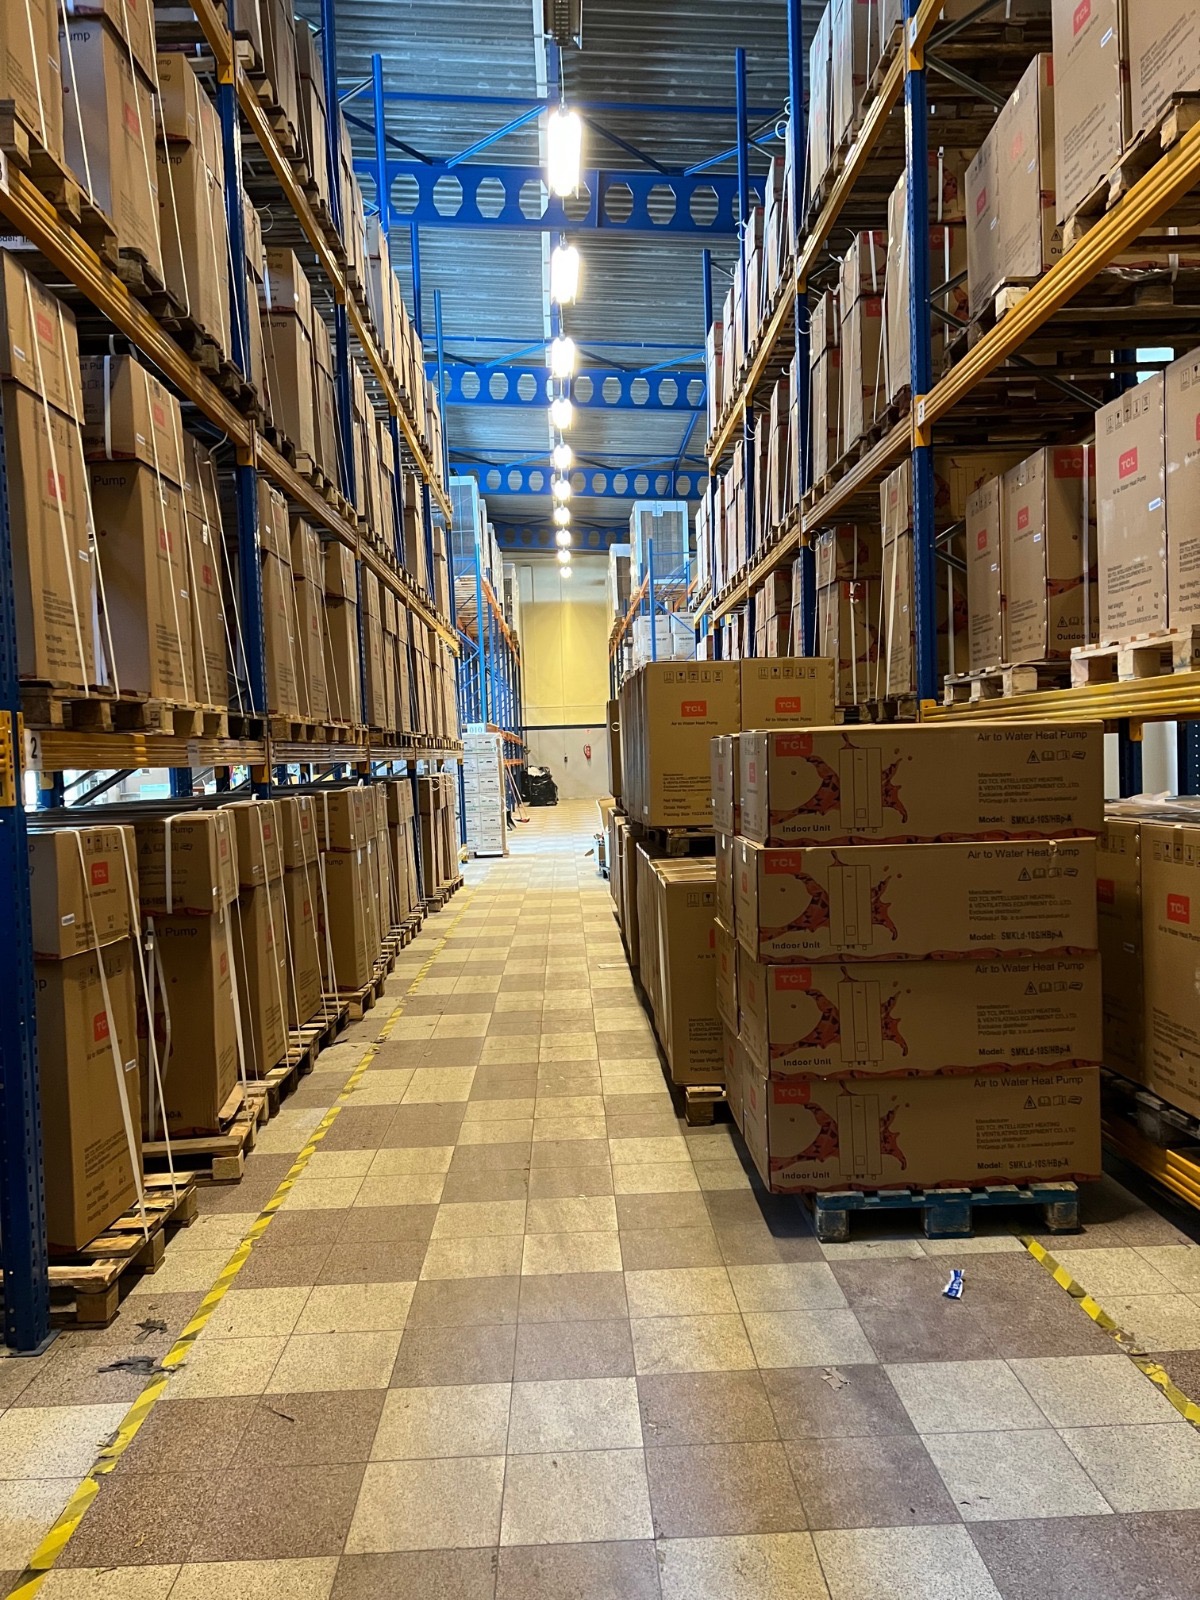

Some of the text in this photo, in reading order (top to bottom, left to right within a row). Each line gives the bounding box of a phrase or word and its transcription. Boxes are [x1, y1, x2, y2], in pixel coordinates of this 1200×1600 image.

[1121, 456, 1136, 470] TCL
[94, 475, 127, 488] Pump
[684, 705, 704, 713] TCL
[977, 731, 1088, 741] Air to Water Heat Pump
[30, 736, 38, 759] 2
[781, 741, 808, 750] TCL
[978, 816, 1005, 824] Model:
[812, 824, 830, 832] Unit
[968, 850, 981, 859] Air
[984, 850, 992, 858] to
[995, 849, 1024, 858] Water
[1026, 849, 1050, 857] Heat
[771, 858, 796, 867] TCL
[93, 870, 106, 879] TCL
[1170, 902, 1187, 915] TCL
[165, 927, 198, 937] Pump
[772, 942, 800, 950] Indoor
[975, 962, 1084, 974] Air to Water Heat Pump
[780, 974, 807, 983] TCL
[978, 1048, 1005, 1056] Model:
[974, 1076, 1084, 1088] Air to Water Heat Pump
[778, 1088, 806, 1097] TCL
